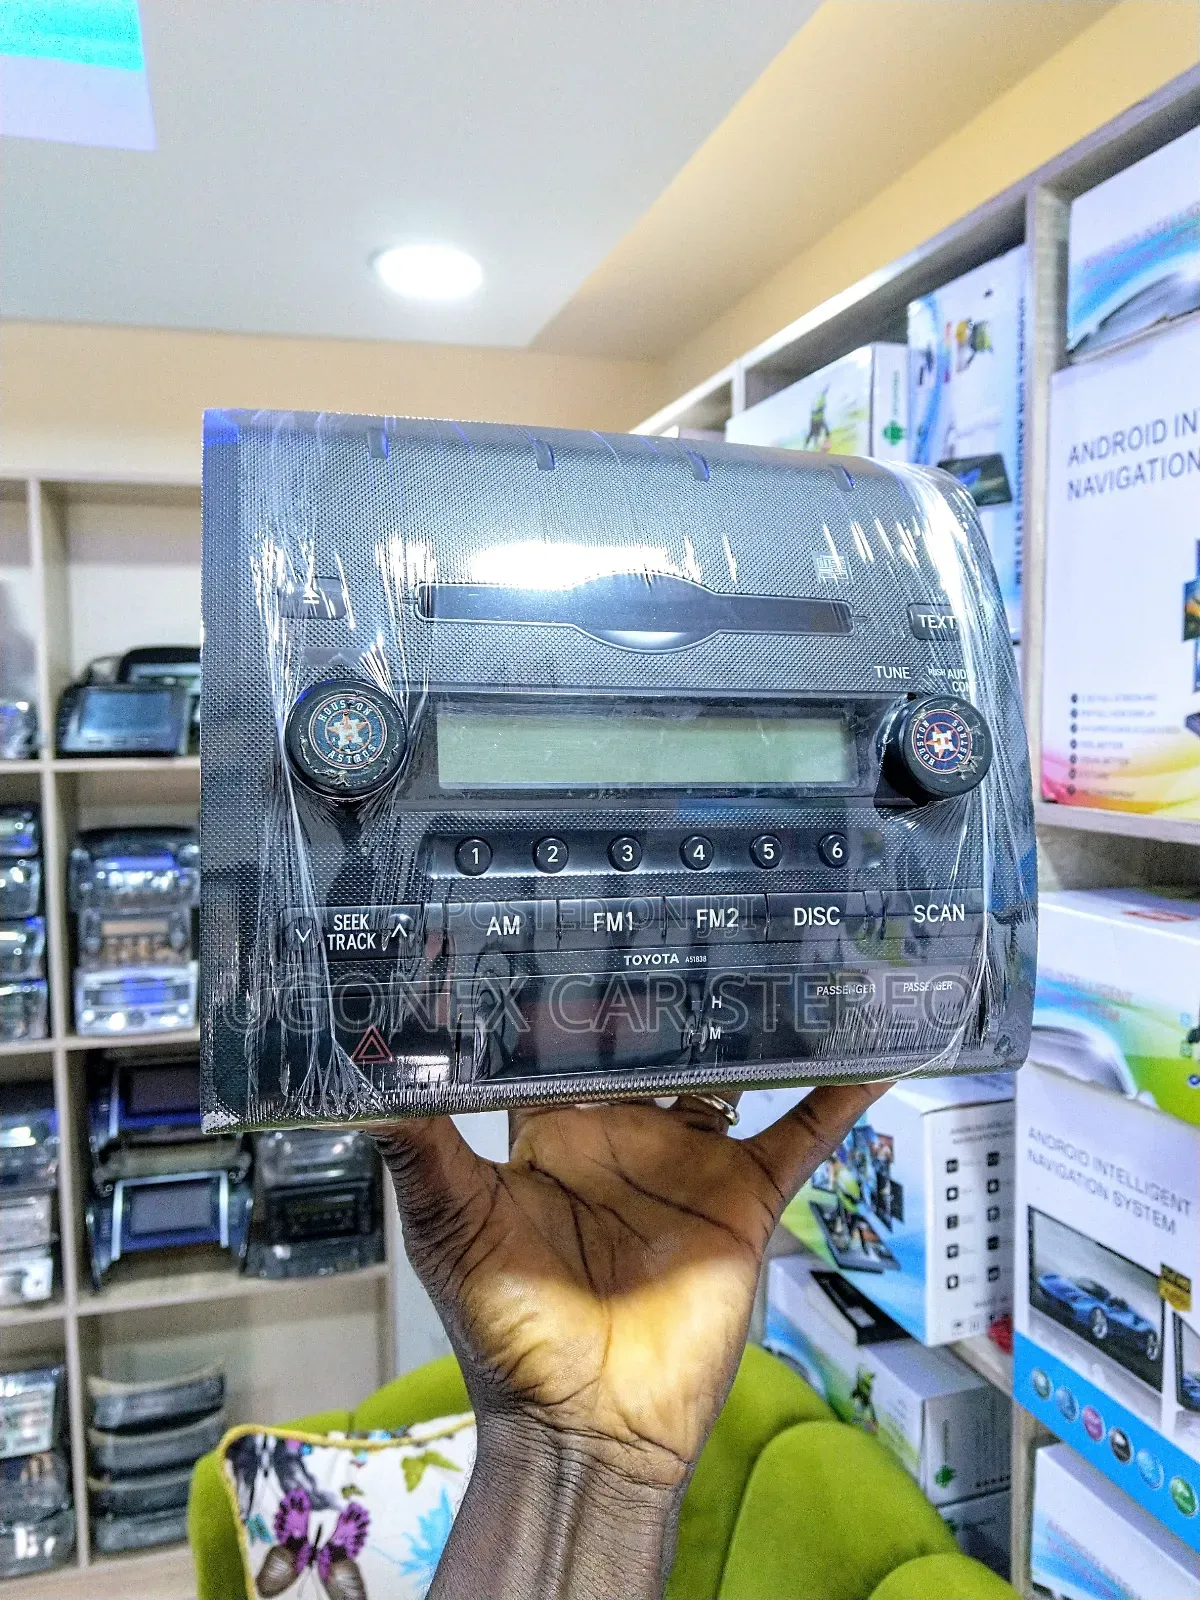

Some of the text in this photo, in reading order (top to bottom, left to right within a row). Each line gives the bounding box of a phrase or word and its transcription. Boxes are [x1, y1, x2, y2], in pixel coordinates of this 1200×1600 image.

[1068, 407, 1200, 468] ANDROID IN
[1068, 450, 1200, 501] NAVIGATION
[917, 613, 957, 629] TEXT
[874, 665, 911, 680] TUNE
[948, 668, 975, 680] AUD
[471, 846, 480, 865] 1
[546, 845, 559, 863] 2
[621, 844, 634, 862] 3
[692, 843, 705, 861] 4
[763, 842, 775, 860] 5
[831, 841, 843, 859] 6
[333, 913, 370, 931] SEEK
[593, 911, 634, 933] FM1
[696, 908, 739, 929] FM2
[793, 906, 841, 926] DISC
[913, 903, 966, 924] SCAN
[486, 915, 521, 936] AM
[327, 932, 377, 951] TRACK
[623, 953, 707, 966] TOYOTA A51838
[816, 983, 876, 996] PASSENGER
[711, 995, 722, 1009] H
[709, 1026, 721, 1040] M
[1028, 1126, 1192, 1216] ANDROID INTELLIGENT
[1027, 1148, 1177, 1236] NAVIGATION SYSTEM
